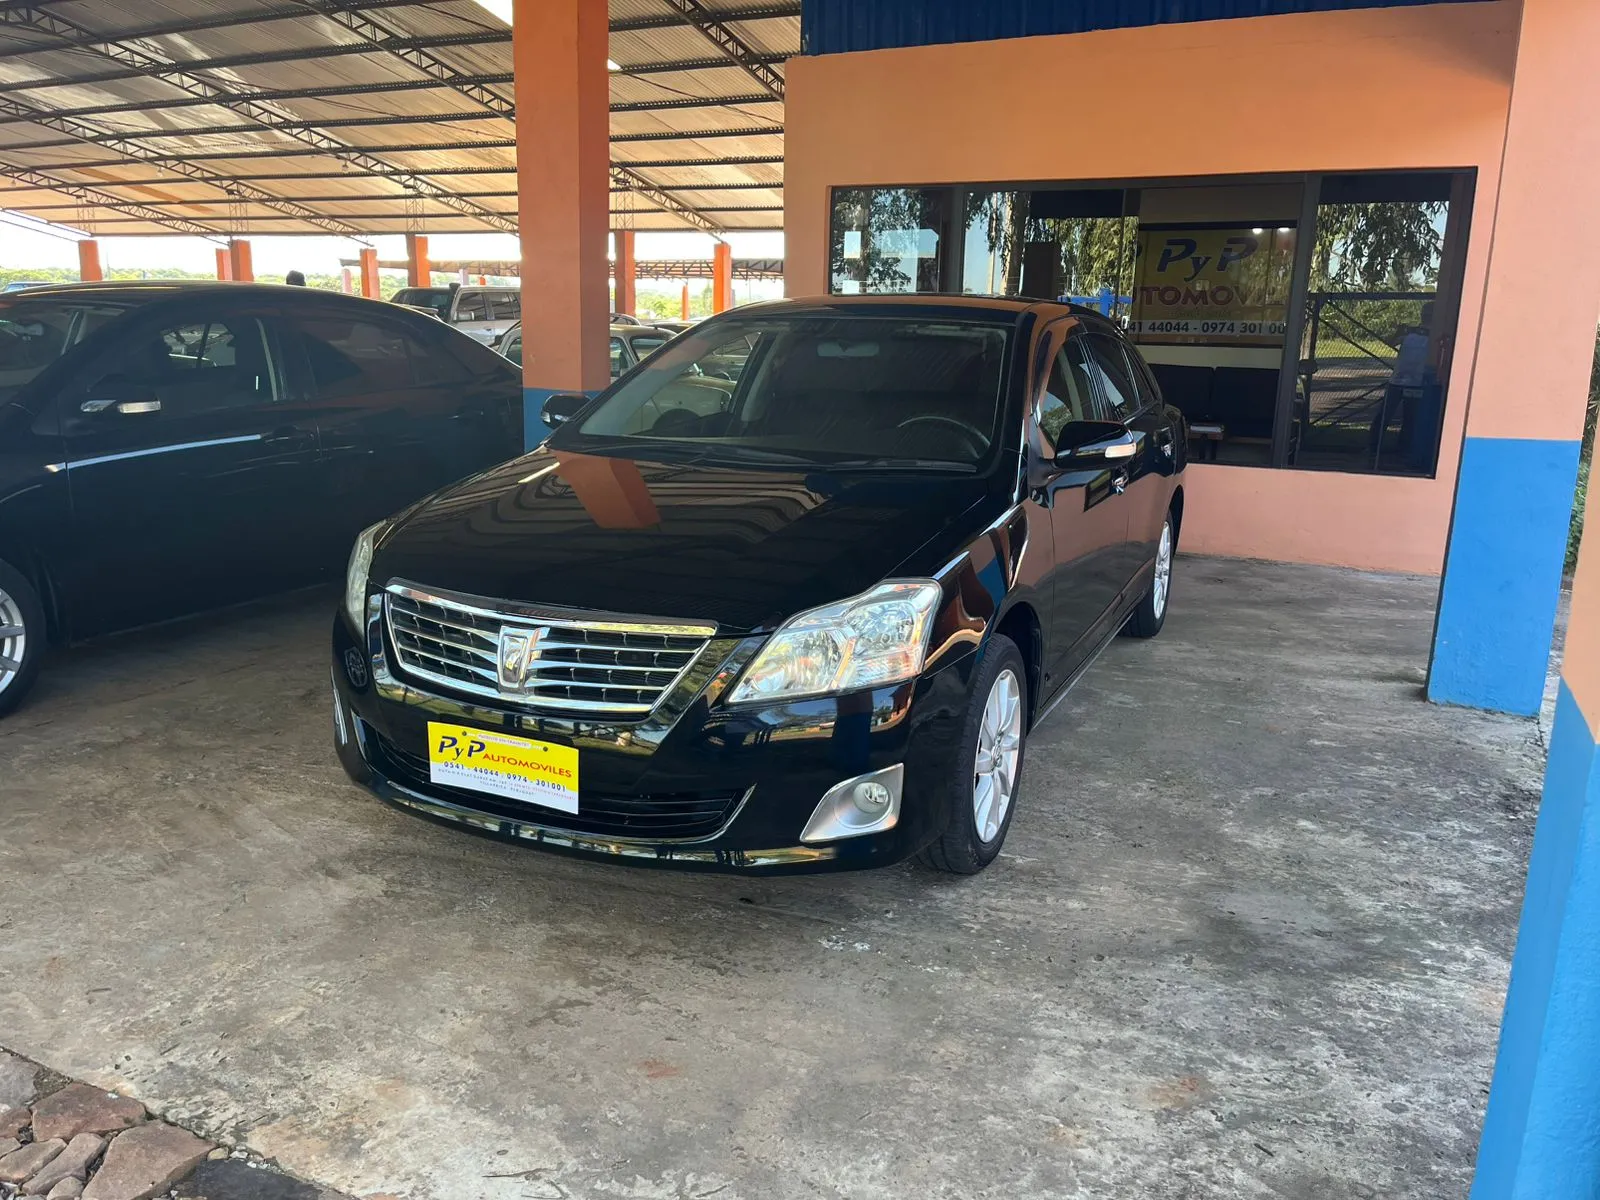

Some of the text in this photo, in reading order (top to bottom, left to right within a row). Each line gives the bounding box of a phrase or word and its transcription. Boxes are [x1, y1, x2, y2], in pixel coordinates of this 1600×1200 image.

[1148, 321, 1189, 333] 44044
[1201, 321, 1235, 333] 0974
[1239, 322, 1262, 334] 301
[438, 735, 486, 760] PyP
[482, 753, 572, 778] AUTOMOVILES
[444, 761, 464, 770] 0541
[473, 766, 499, 777] 44044
[507, 773, 528, 783] 0974
[535, 778, 566, 792] 301001
